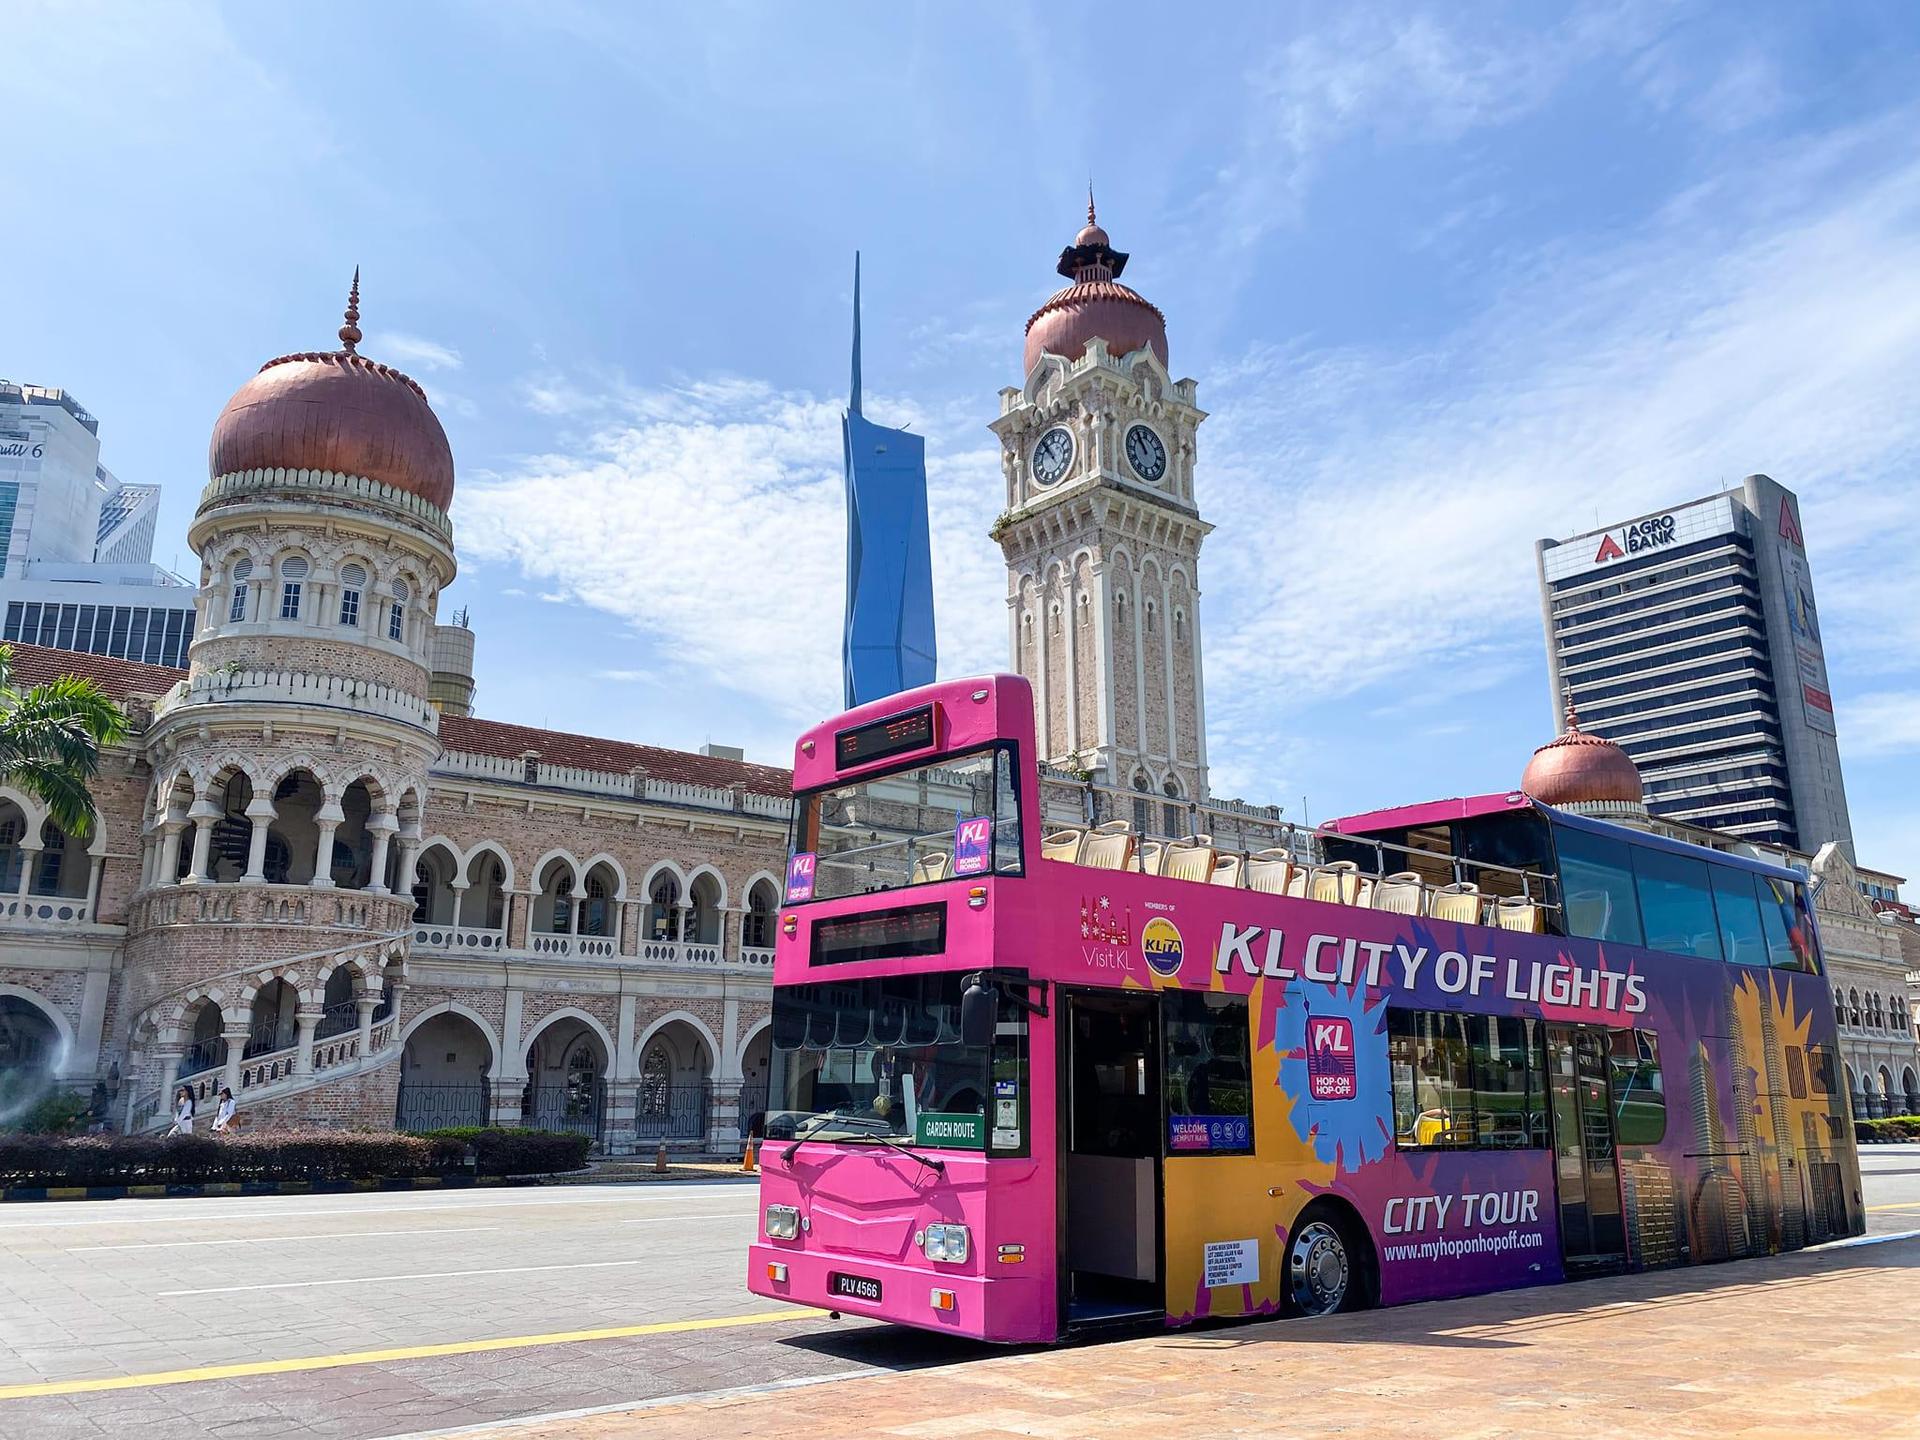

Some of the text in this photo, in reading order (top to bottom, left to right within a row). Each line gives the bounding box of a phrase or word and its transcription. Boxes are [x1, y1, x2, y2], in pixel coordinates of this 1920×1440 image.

[0, 443, 45, 458] uill 6
[1628, 515, 1674, 539] AGRO
[1628, 527, 1677, 552] BANK
[960, 823, 985, 843] KL
[793, 858, 812, 875] KL
[1215, 921, 1647, 1013] KL CITY OF LIGHTS
[1315, 1024, 1349, 1051] KL
[1316, 1077, 1350, 1086] HOP-ON
[1316, 1085, 1351, 1095] HOP-OFF
[925, 1121, 975, 1138] GARDEN ROUTE
[1172, 1123, 1208, 1133] WELCOME
[1383, 1189, 1539, 1234] CITY TOUR
[1384, 1230, 1543, 1262] www.myhoponhopoff.com
[841, 1277, 878, 1298] PLV 4566
